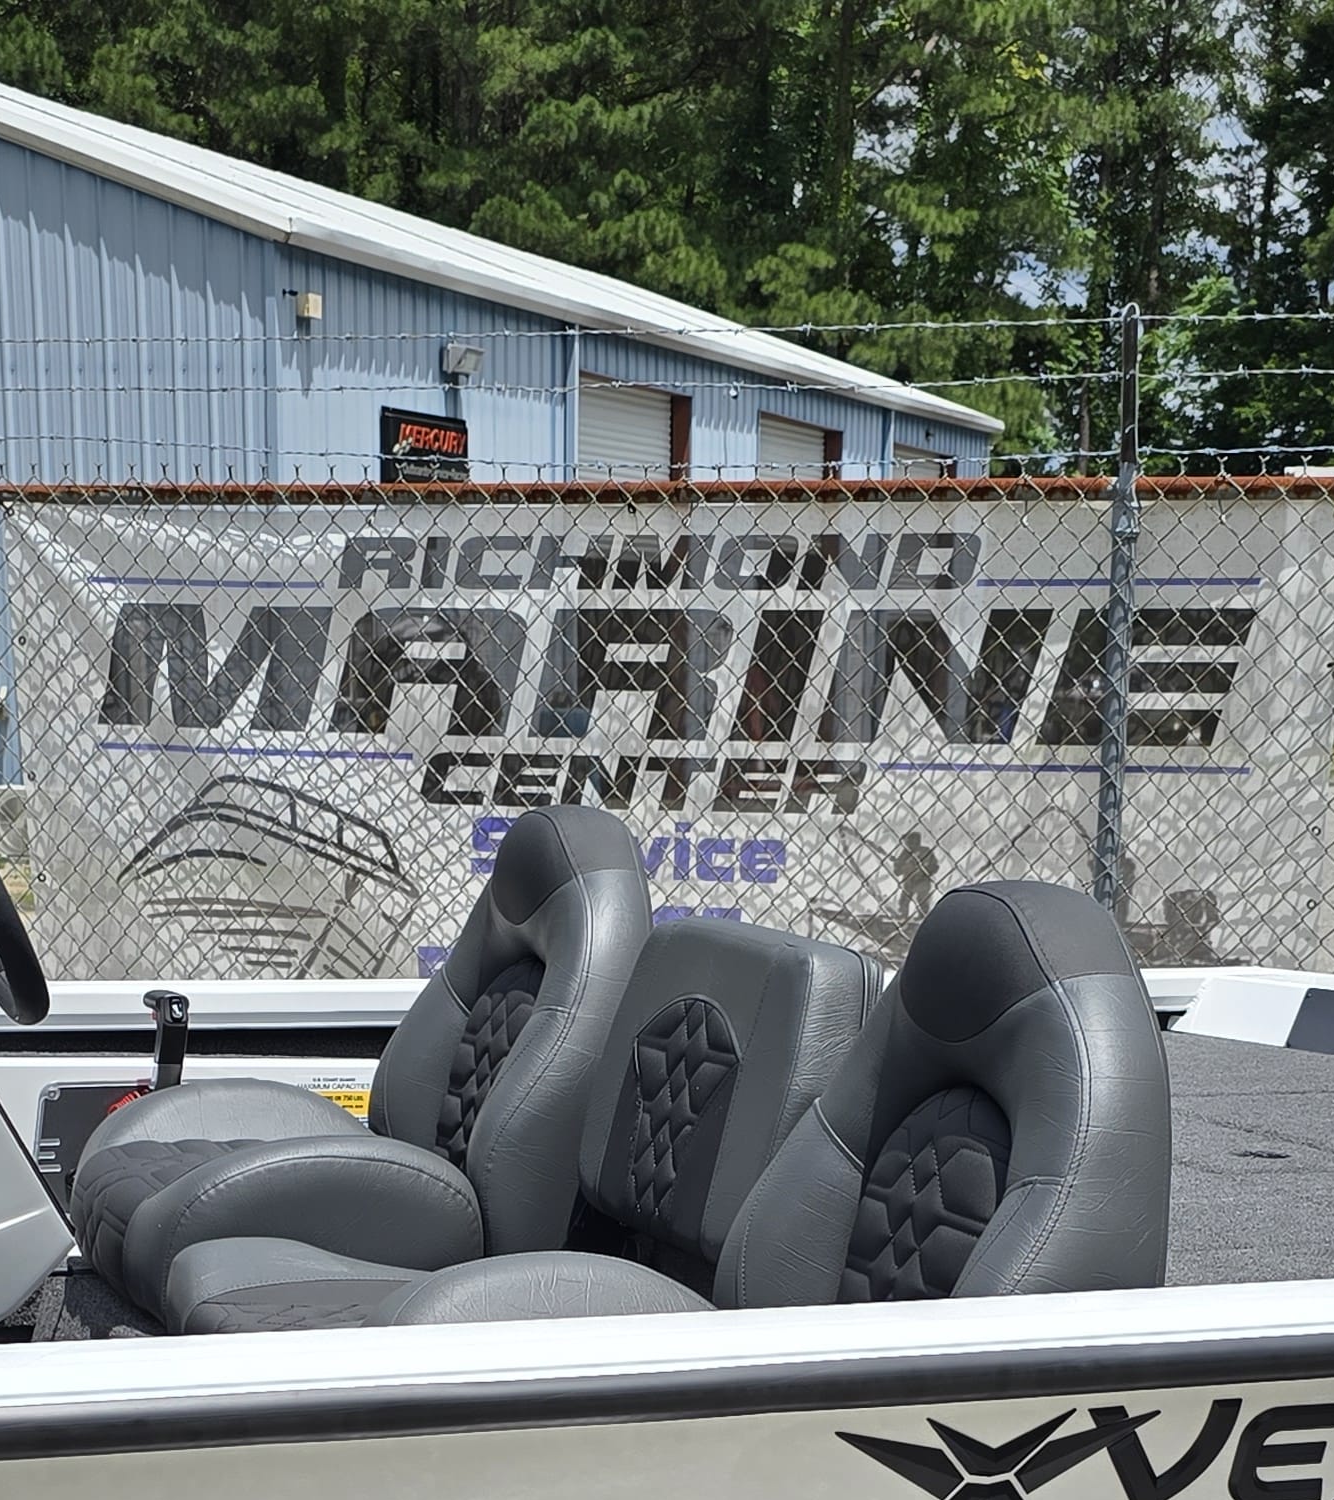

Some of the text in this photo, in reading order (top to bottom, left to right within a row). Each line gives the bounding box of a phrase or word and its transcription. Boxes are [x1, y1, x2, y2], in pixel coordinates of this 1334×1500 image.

[399, 423, 466, 455] MERCURY
[337, 533, 981, 590] RICHMOND
[98, 602, 1259, 746] MARINE
[420, 753, 869, 815] CENTER
